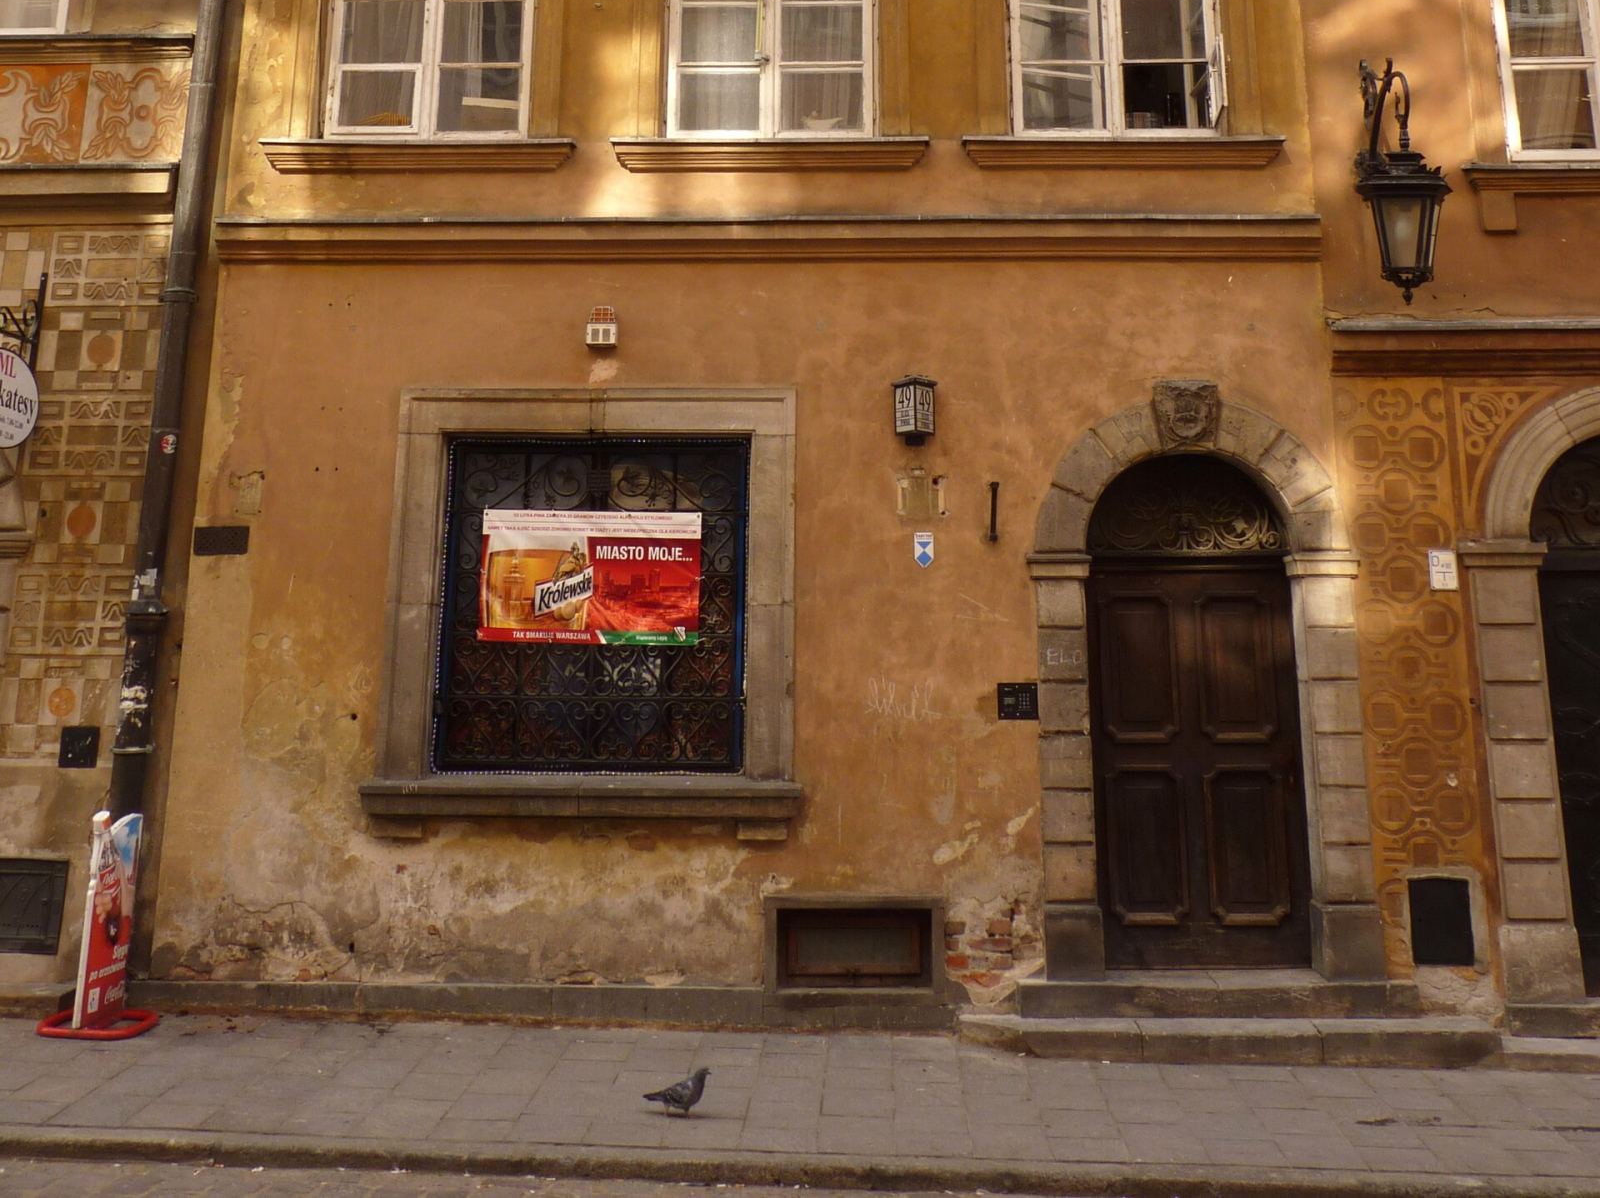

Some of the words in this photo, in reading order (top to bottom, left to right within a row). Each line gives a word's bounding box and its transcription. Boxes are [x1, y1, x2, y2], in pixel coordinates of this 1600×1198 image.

[898, 385, 912, 408] 49
[919, 389, 931, 412] 49
[595, 545, 645, 561] MIASTO
[648, 547, 693, 562] MOJE...
[537, 572, 592, 612] Królewskie
[512, 631, 525, 639] TAK
